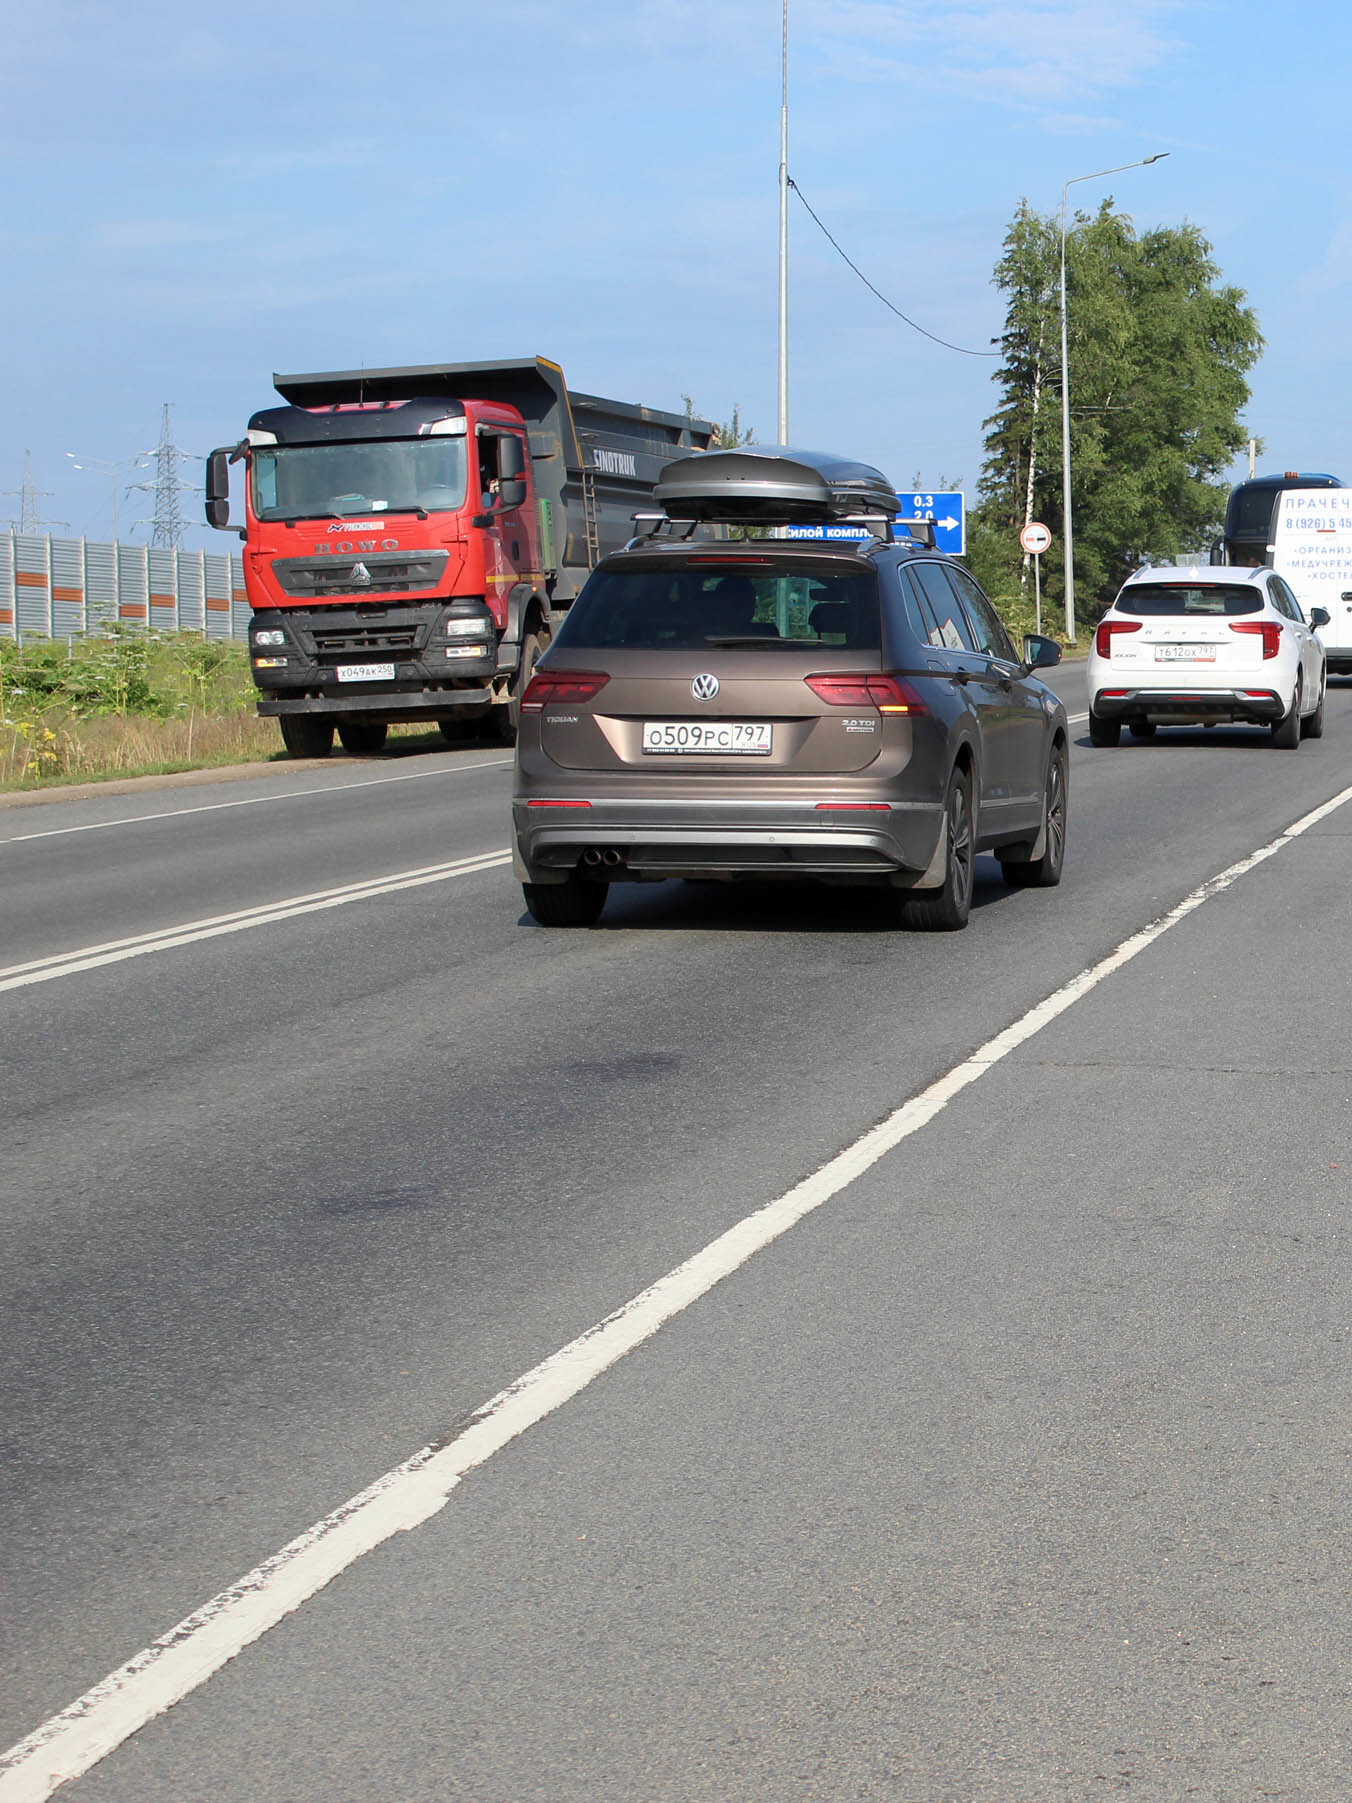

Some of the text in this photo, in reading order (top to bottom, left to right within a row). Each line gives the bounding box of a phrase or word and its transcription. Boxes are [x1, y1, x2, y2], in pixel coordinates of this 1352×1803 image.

[593, 448, 636, 477] SINOTRUK
[913, 495, 934, 508] 0.3
[913, 509, 934, 519] 20
[1286, 518, 1293, 529] 8
[1295, 517, 1326, 530] (926)
[787, 525, 874, 538] илой компл
[314, 538, 399, 554] HOWO
[858, 719, 876, 727] TDI
[735, 726, 765, 742] 797
